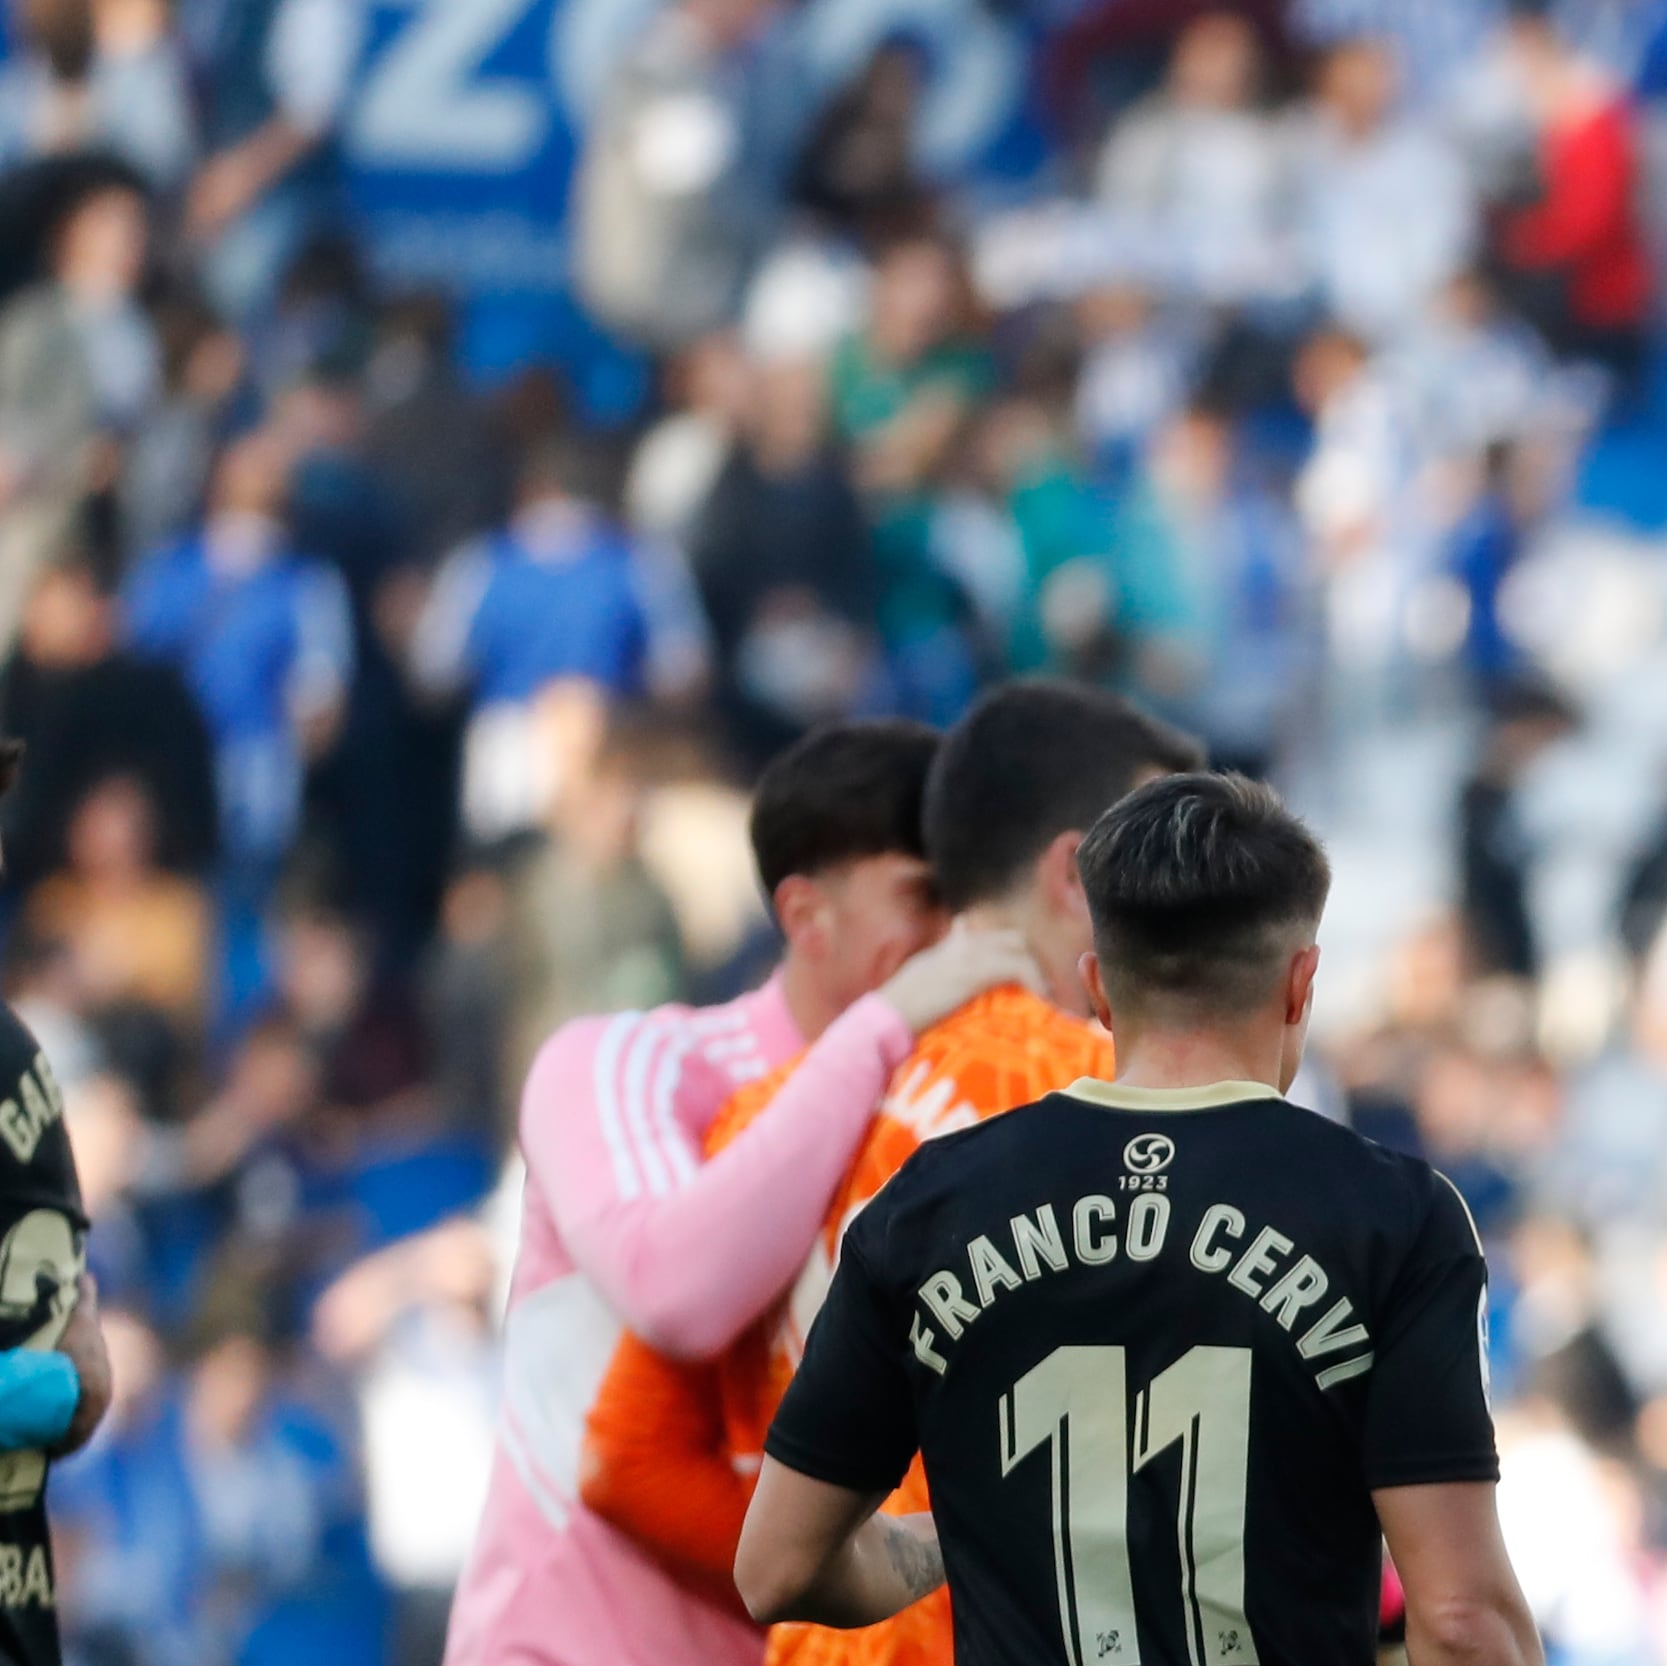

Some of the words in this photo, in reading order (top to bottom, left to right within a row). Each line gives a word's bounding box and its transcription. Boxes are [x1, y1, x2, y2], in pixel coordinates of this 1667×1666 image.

[1117, 1174, 1169, 1191] 1923
[908, 1192, 1172, 1376] FRANCO
[1189, 1203, 1376, 1392] CERVI
